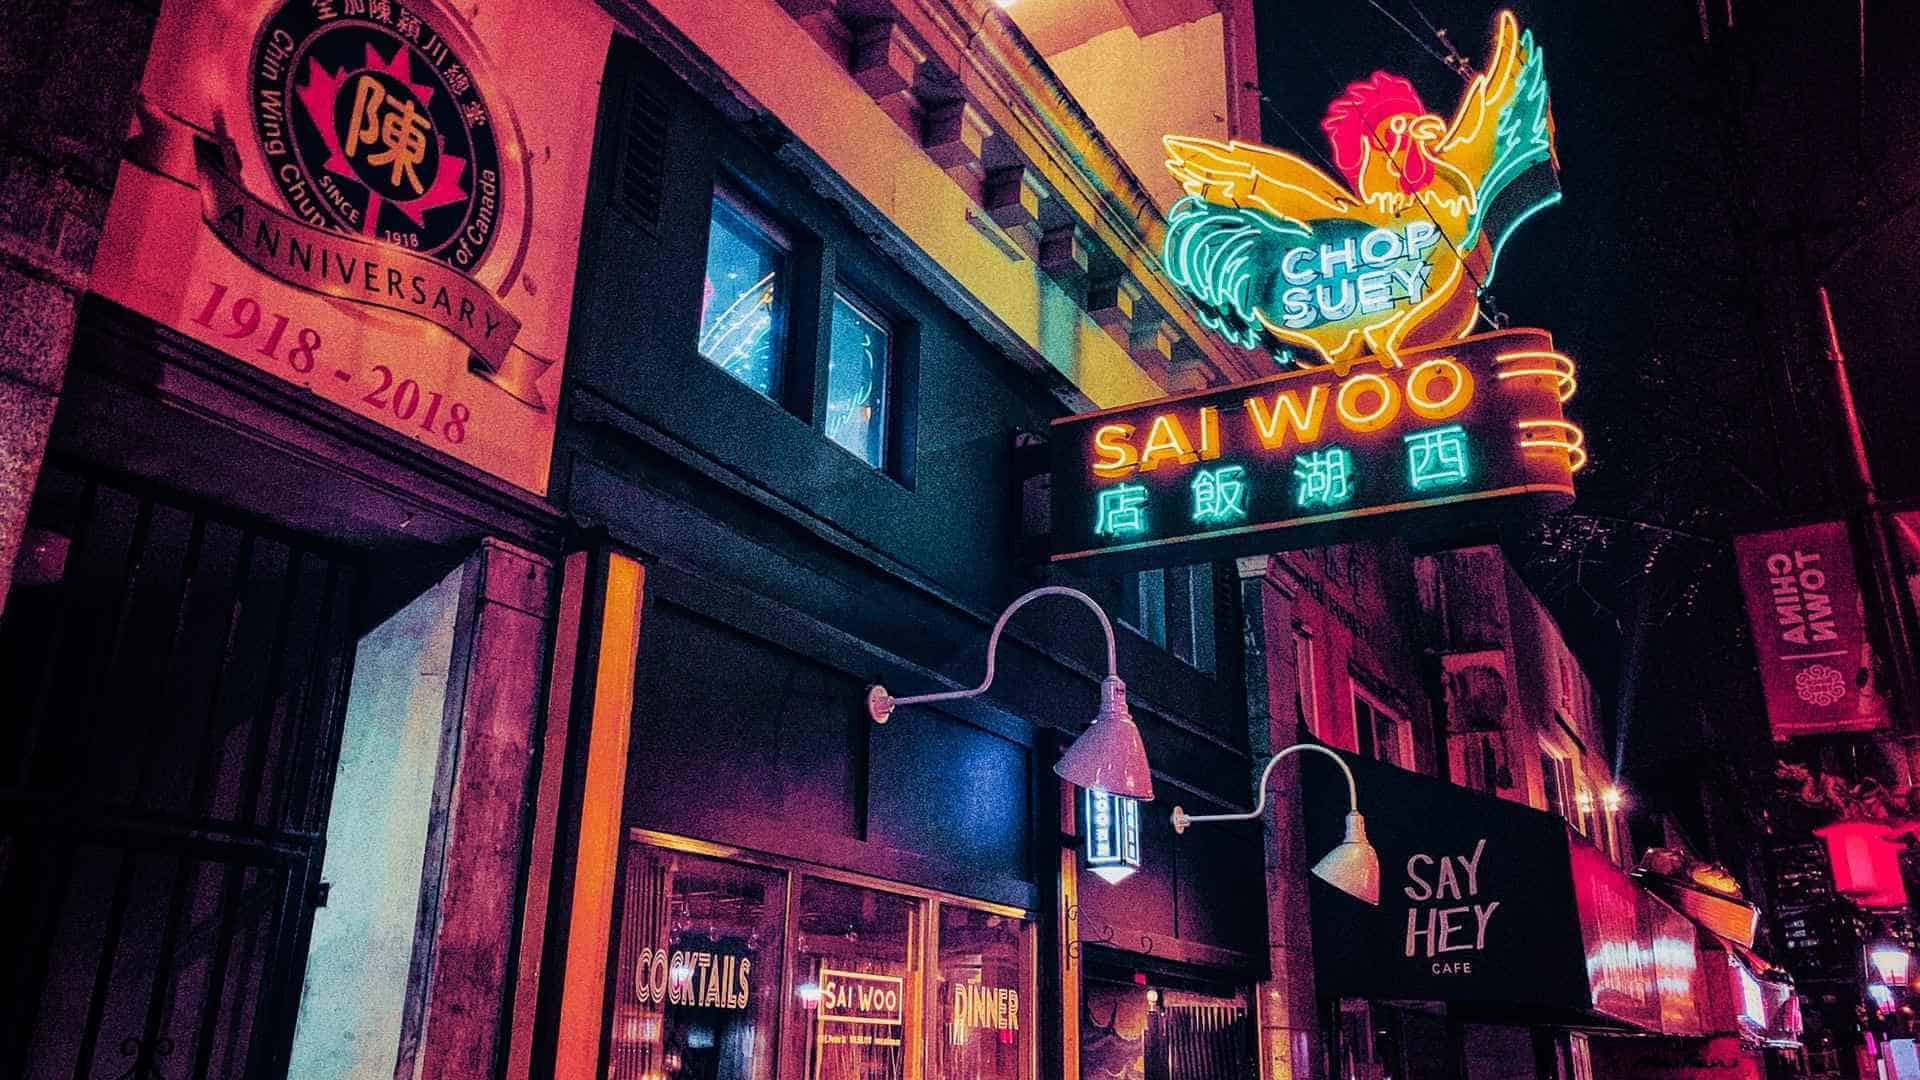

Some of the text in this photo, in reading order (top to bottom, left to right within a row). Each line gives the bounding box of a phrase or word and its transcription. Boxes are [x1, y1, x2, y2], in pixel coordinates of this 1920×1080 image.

[262, 29, 294, 81] Chin
[262, 88, 287, 156] Wing
[345, 75, 432, 195] 陳
[318, 175, 361, 225] SINCE
[456, 169, 496, 265] of Canada
[383, 230, 419, 248] 1918
[1282, 220, 1443, 287] CHOP
[220, 205, 501, 338] ANNIVERSARY
[1282, 261, 1434, 330] SUEY
[191, 281, 322, 374] 1918
[362, 364, 471, 446] 2018
[1092, 356, 1475, 479] SAI WOO
[1404, 838, 1487, 901] SAY
[1404, 901, 1500, 958] HEY
[635, 947, 752, 1010] COCKTAILS
[824, 981, 897, 1012] SAI WOO
[1431, 962, 1473, 975] CAFE
[953, 982, 1020, 1031] DINNER
